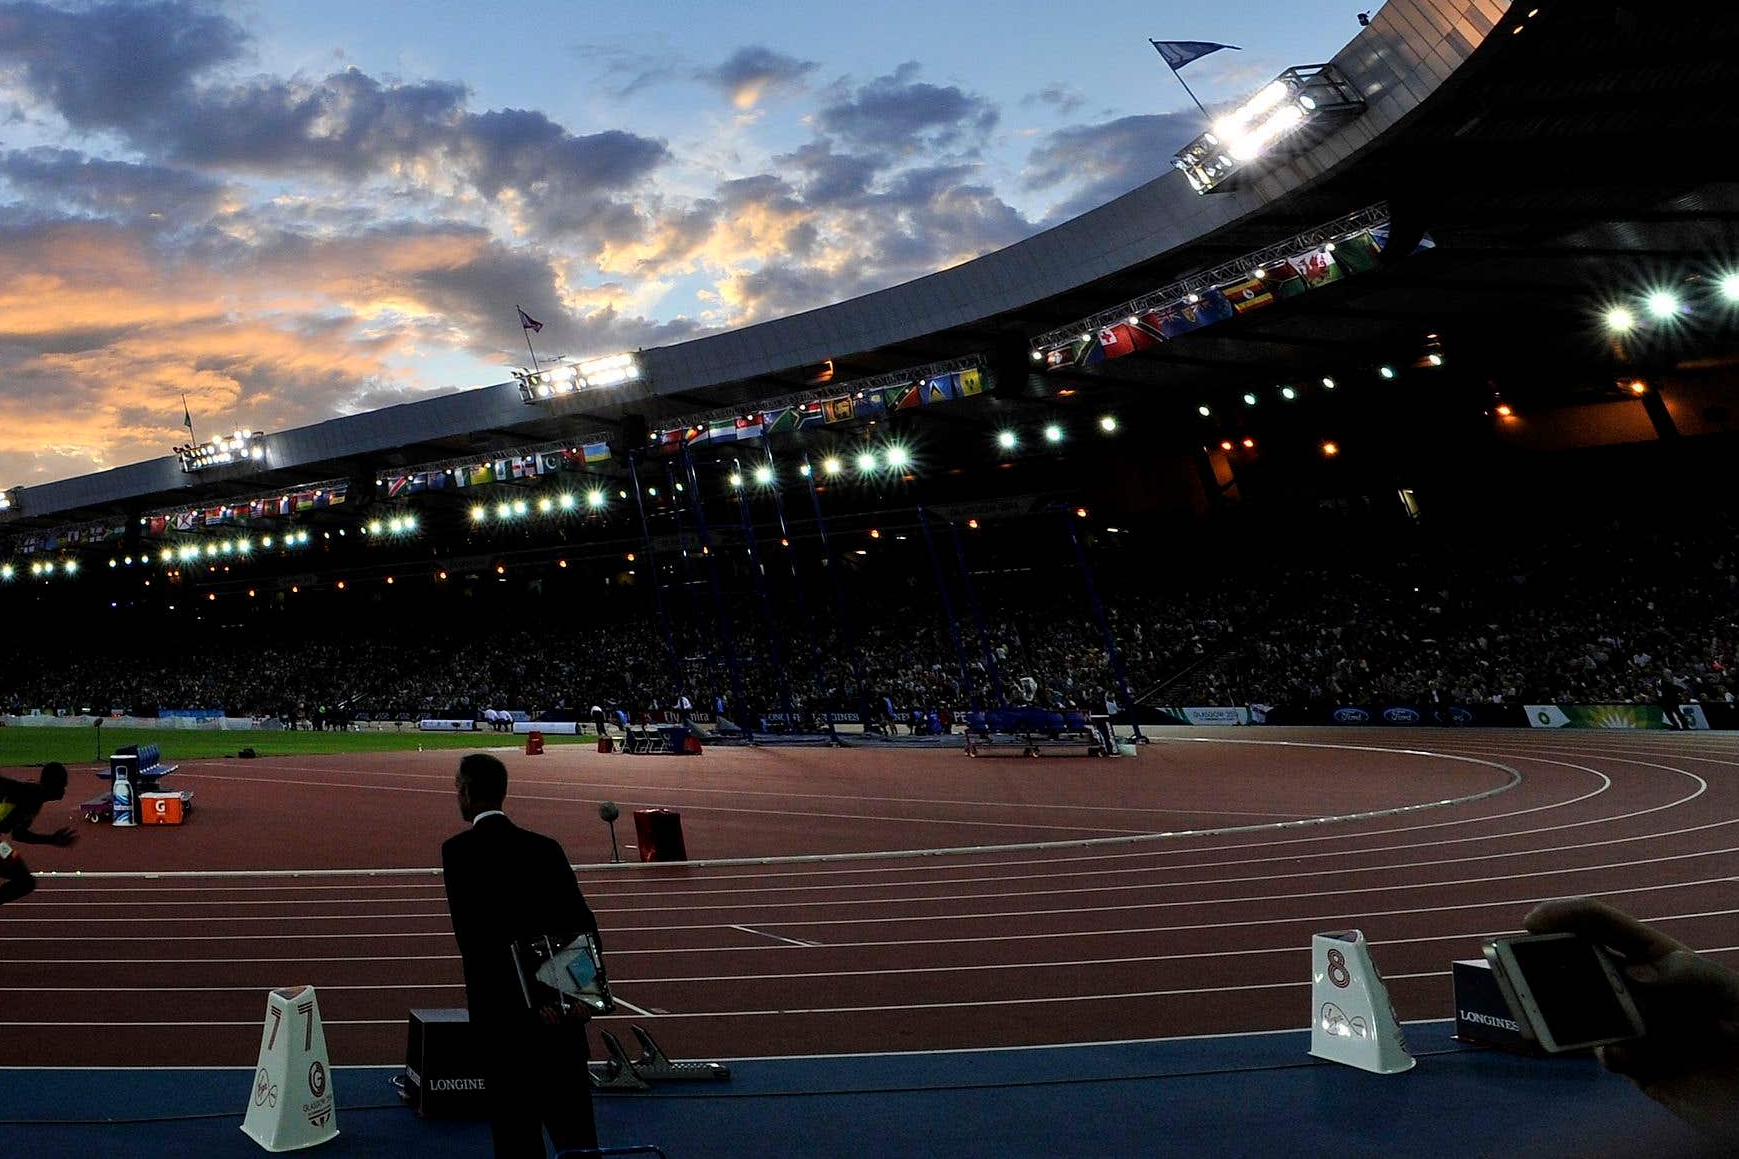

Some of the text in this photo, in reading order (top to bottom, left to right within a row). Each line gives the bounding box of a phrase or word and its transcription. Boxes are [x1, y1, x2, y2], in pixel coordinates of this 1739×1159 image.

[1340, 712, 1362, 721] Ford
[1390, 711, 1412, 721] Ford
[155, 799, 166, 813] G
[1327, 948, 1350, 989] 8
[267, 1005, 282, 1051] 7
[297, 1001, 313, 1051] 7
[1459, 1009, 1520, 1031] LONGINES
[429, 1078, 486, 1091] LONGINE
